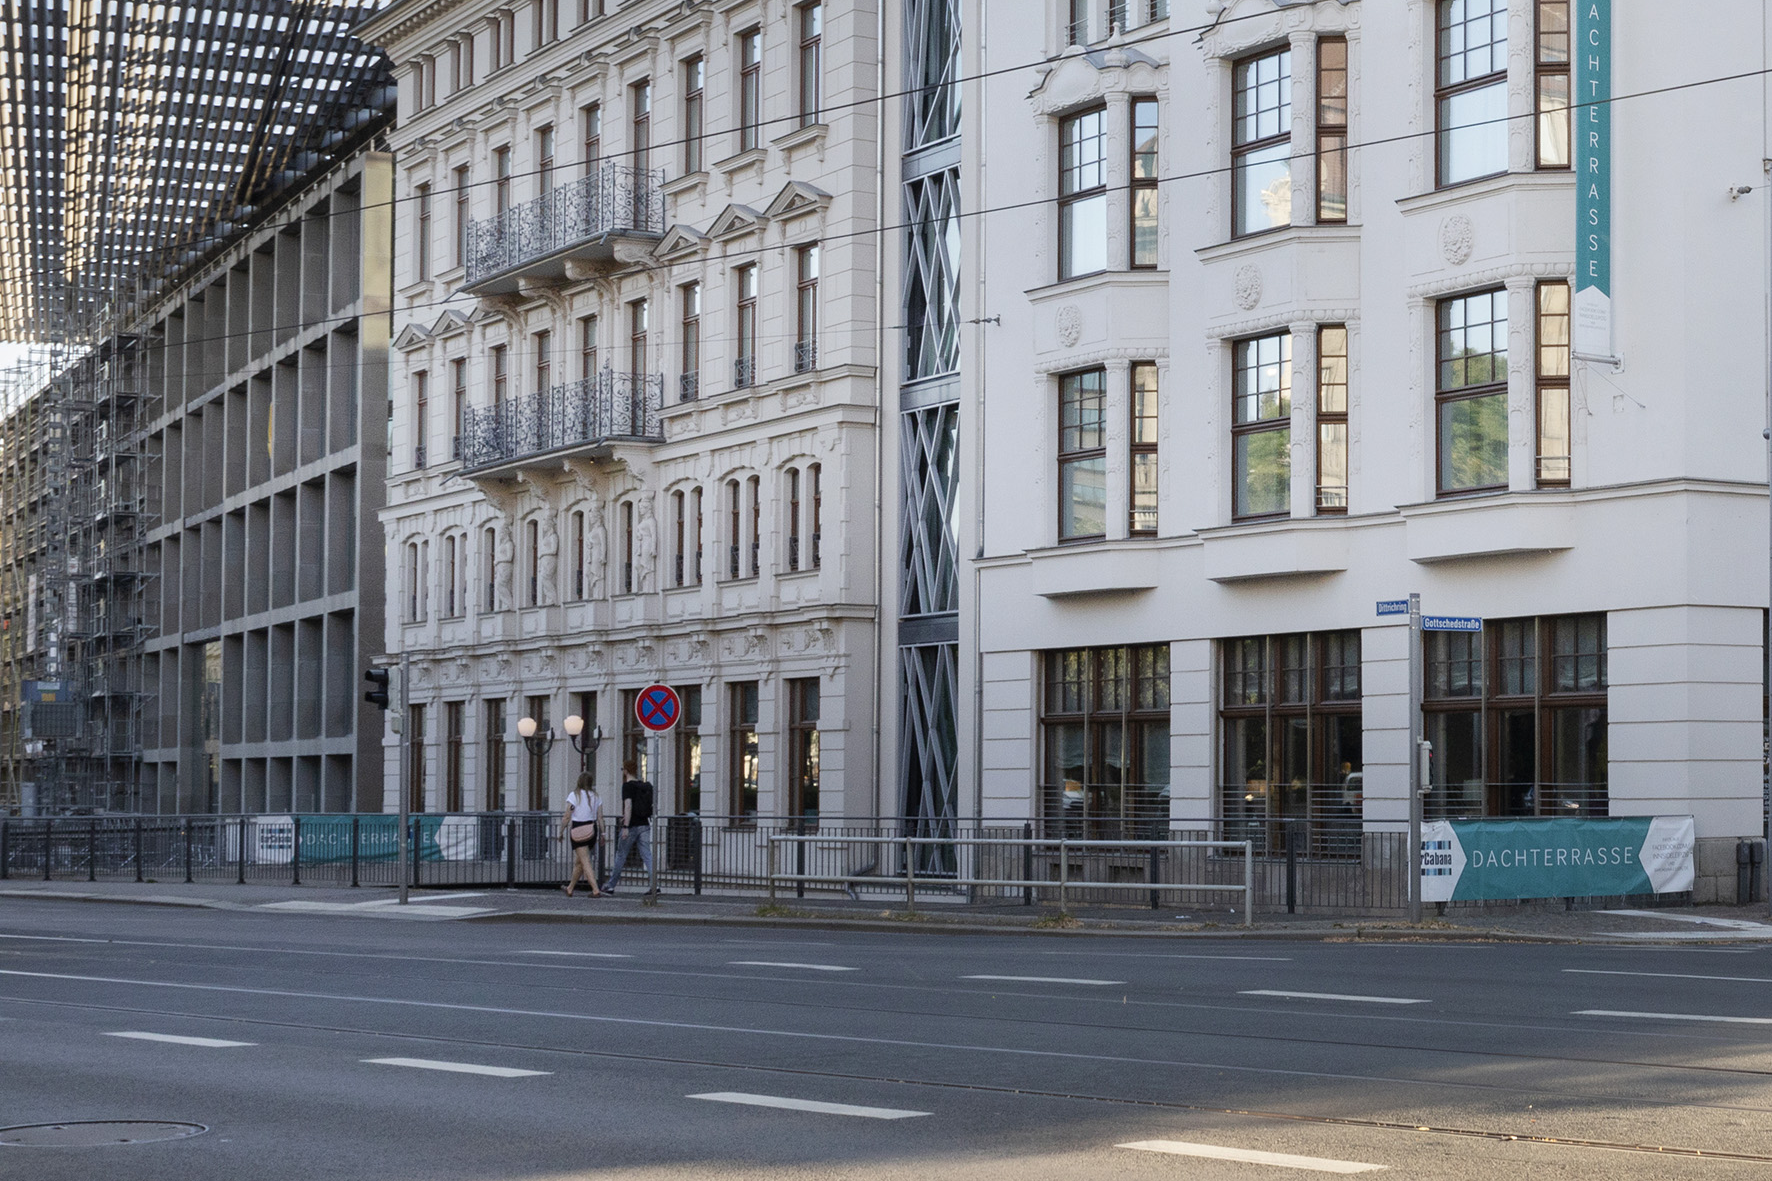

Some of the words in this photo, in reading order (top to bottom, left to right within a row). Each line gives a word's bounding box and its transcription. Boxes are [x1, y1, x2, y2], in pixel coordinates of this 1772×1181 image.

[1378, 602, 1407, 613] Dittrichring
[1424, 617, 1480, 629] Gottschedstraße
[1473, 846, 1633, 868] DACHTERRASSE
